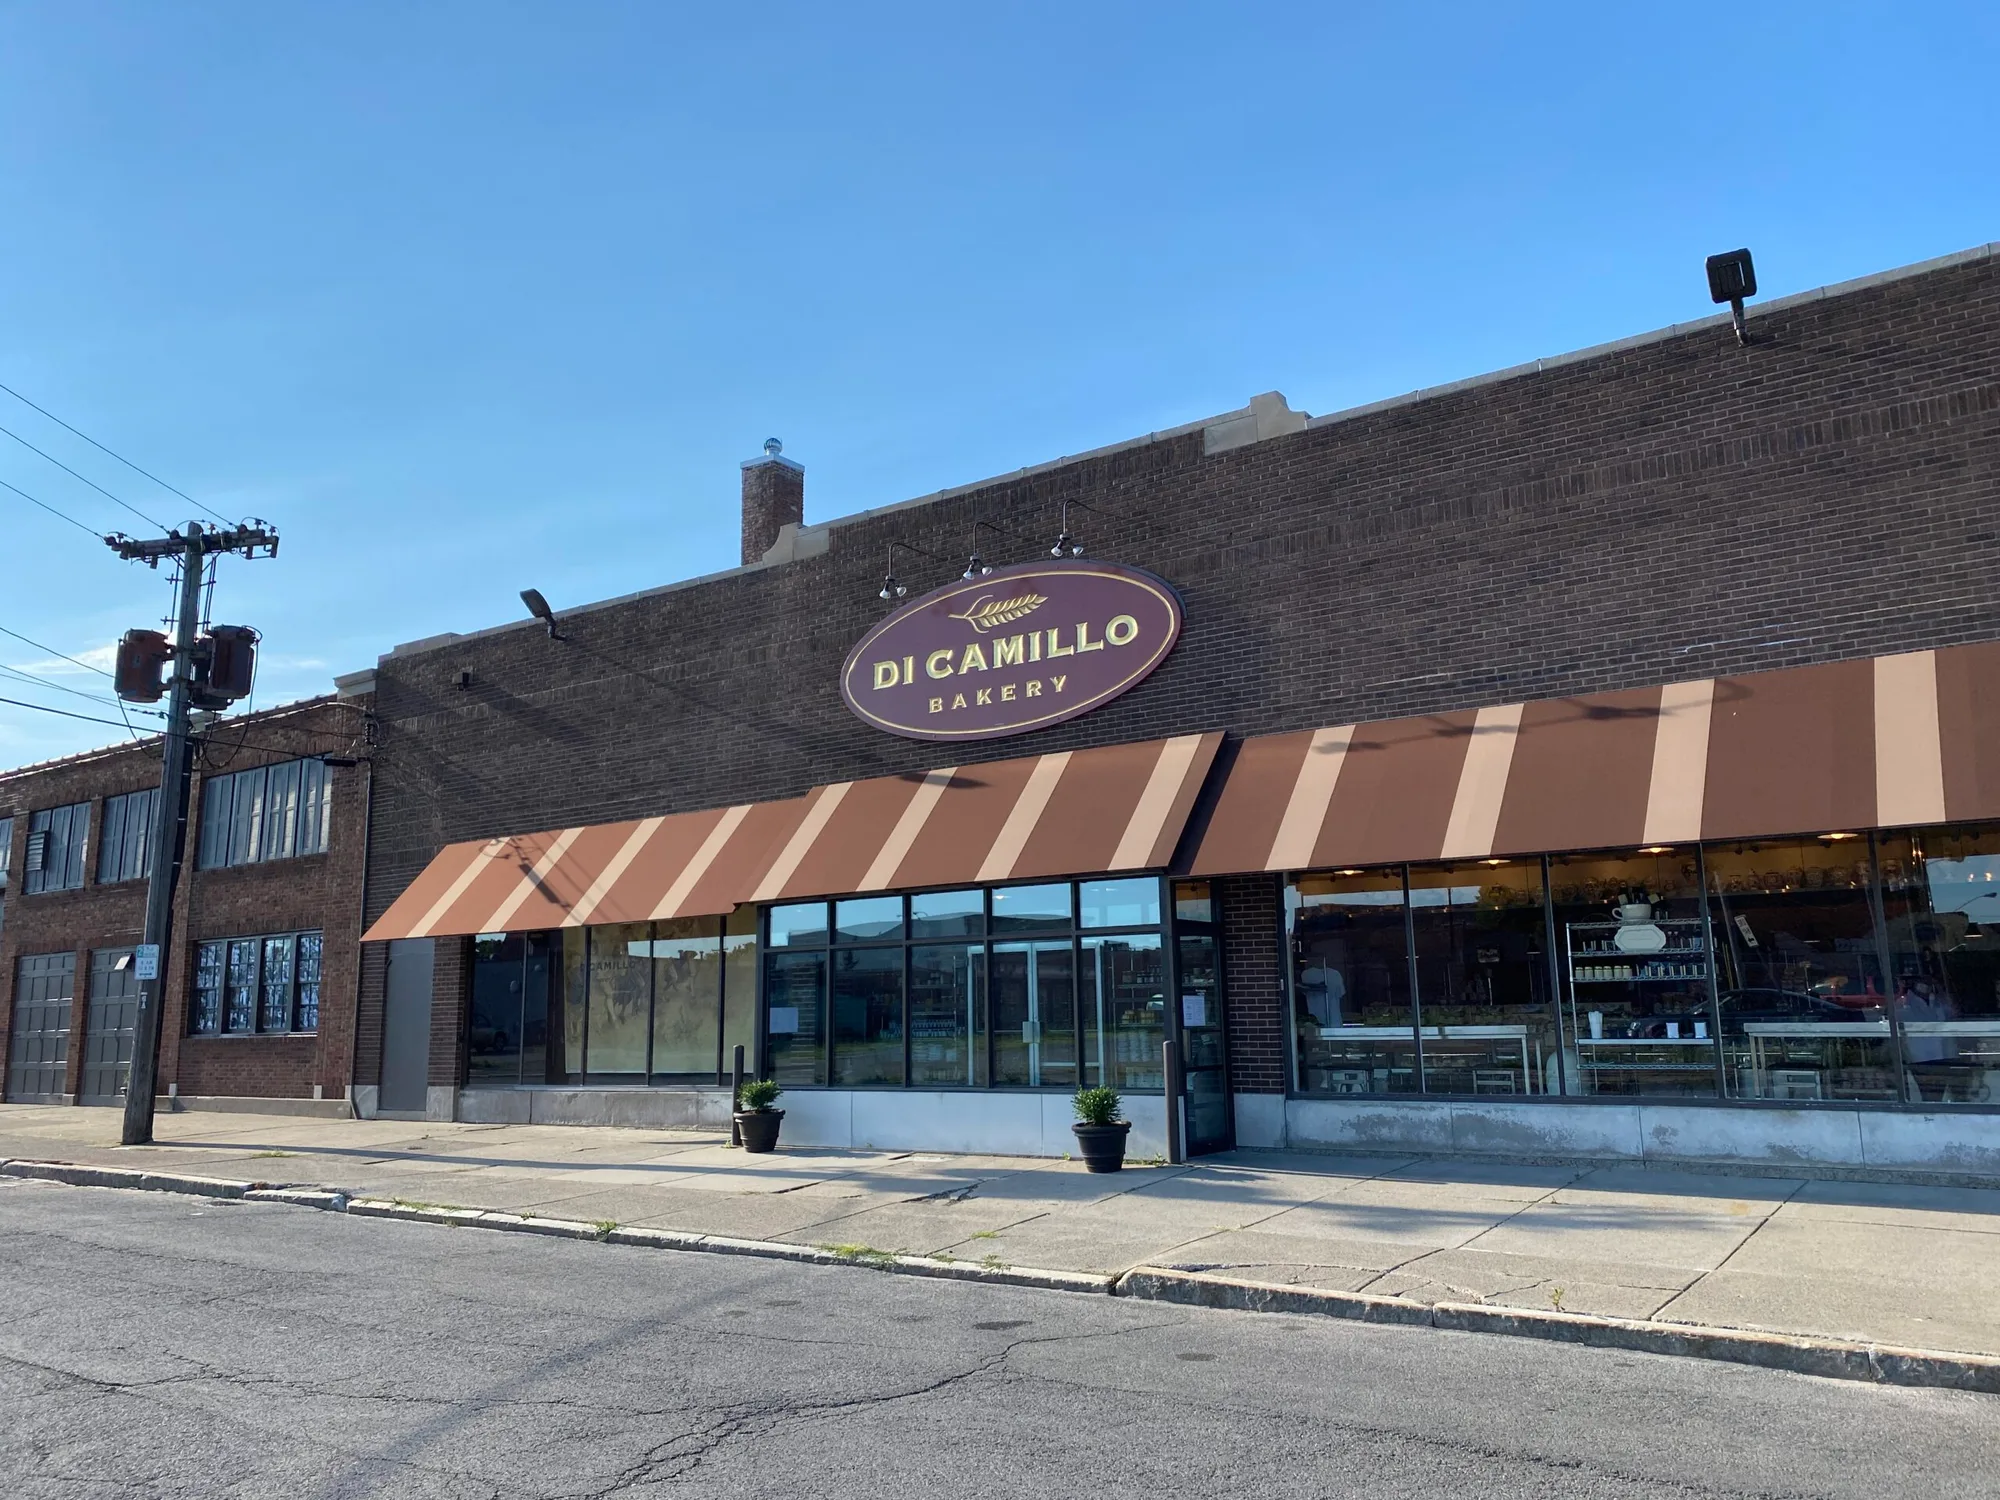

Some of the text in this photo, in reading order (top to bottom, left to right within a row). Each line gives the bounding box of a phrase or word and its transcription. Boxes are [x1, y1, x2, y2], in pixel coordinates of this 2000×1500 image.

[873, 614, 1139, 690] DI CAMILLO
[928, 675, 1068, 714] BAKERY
